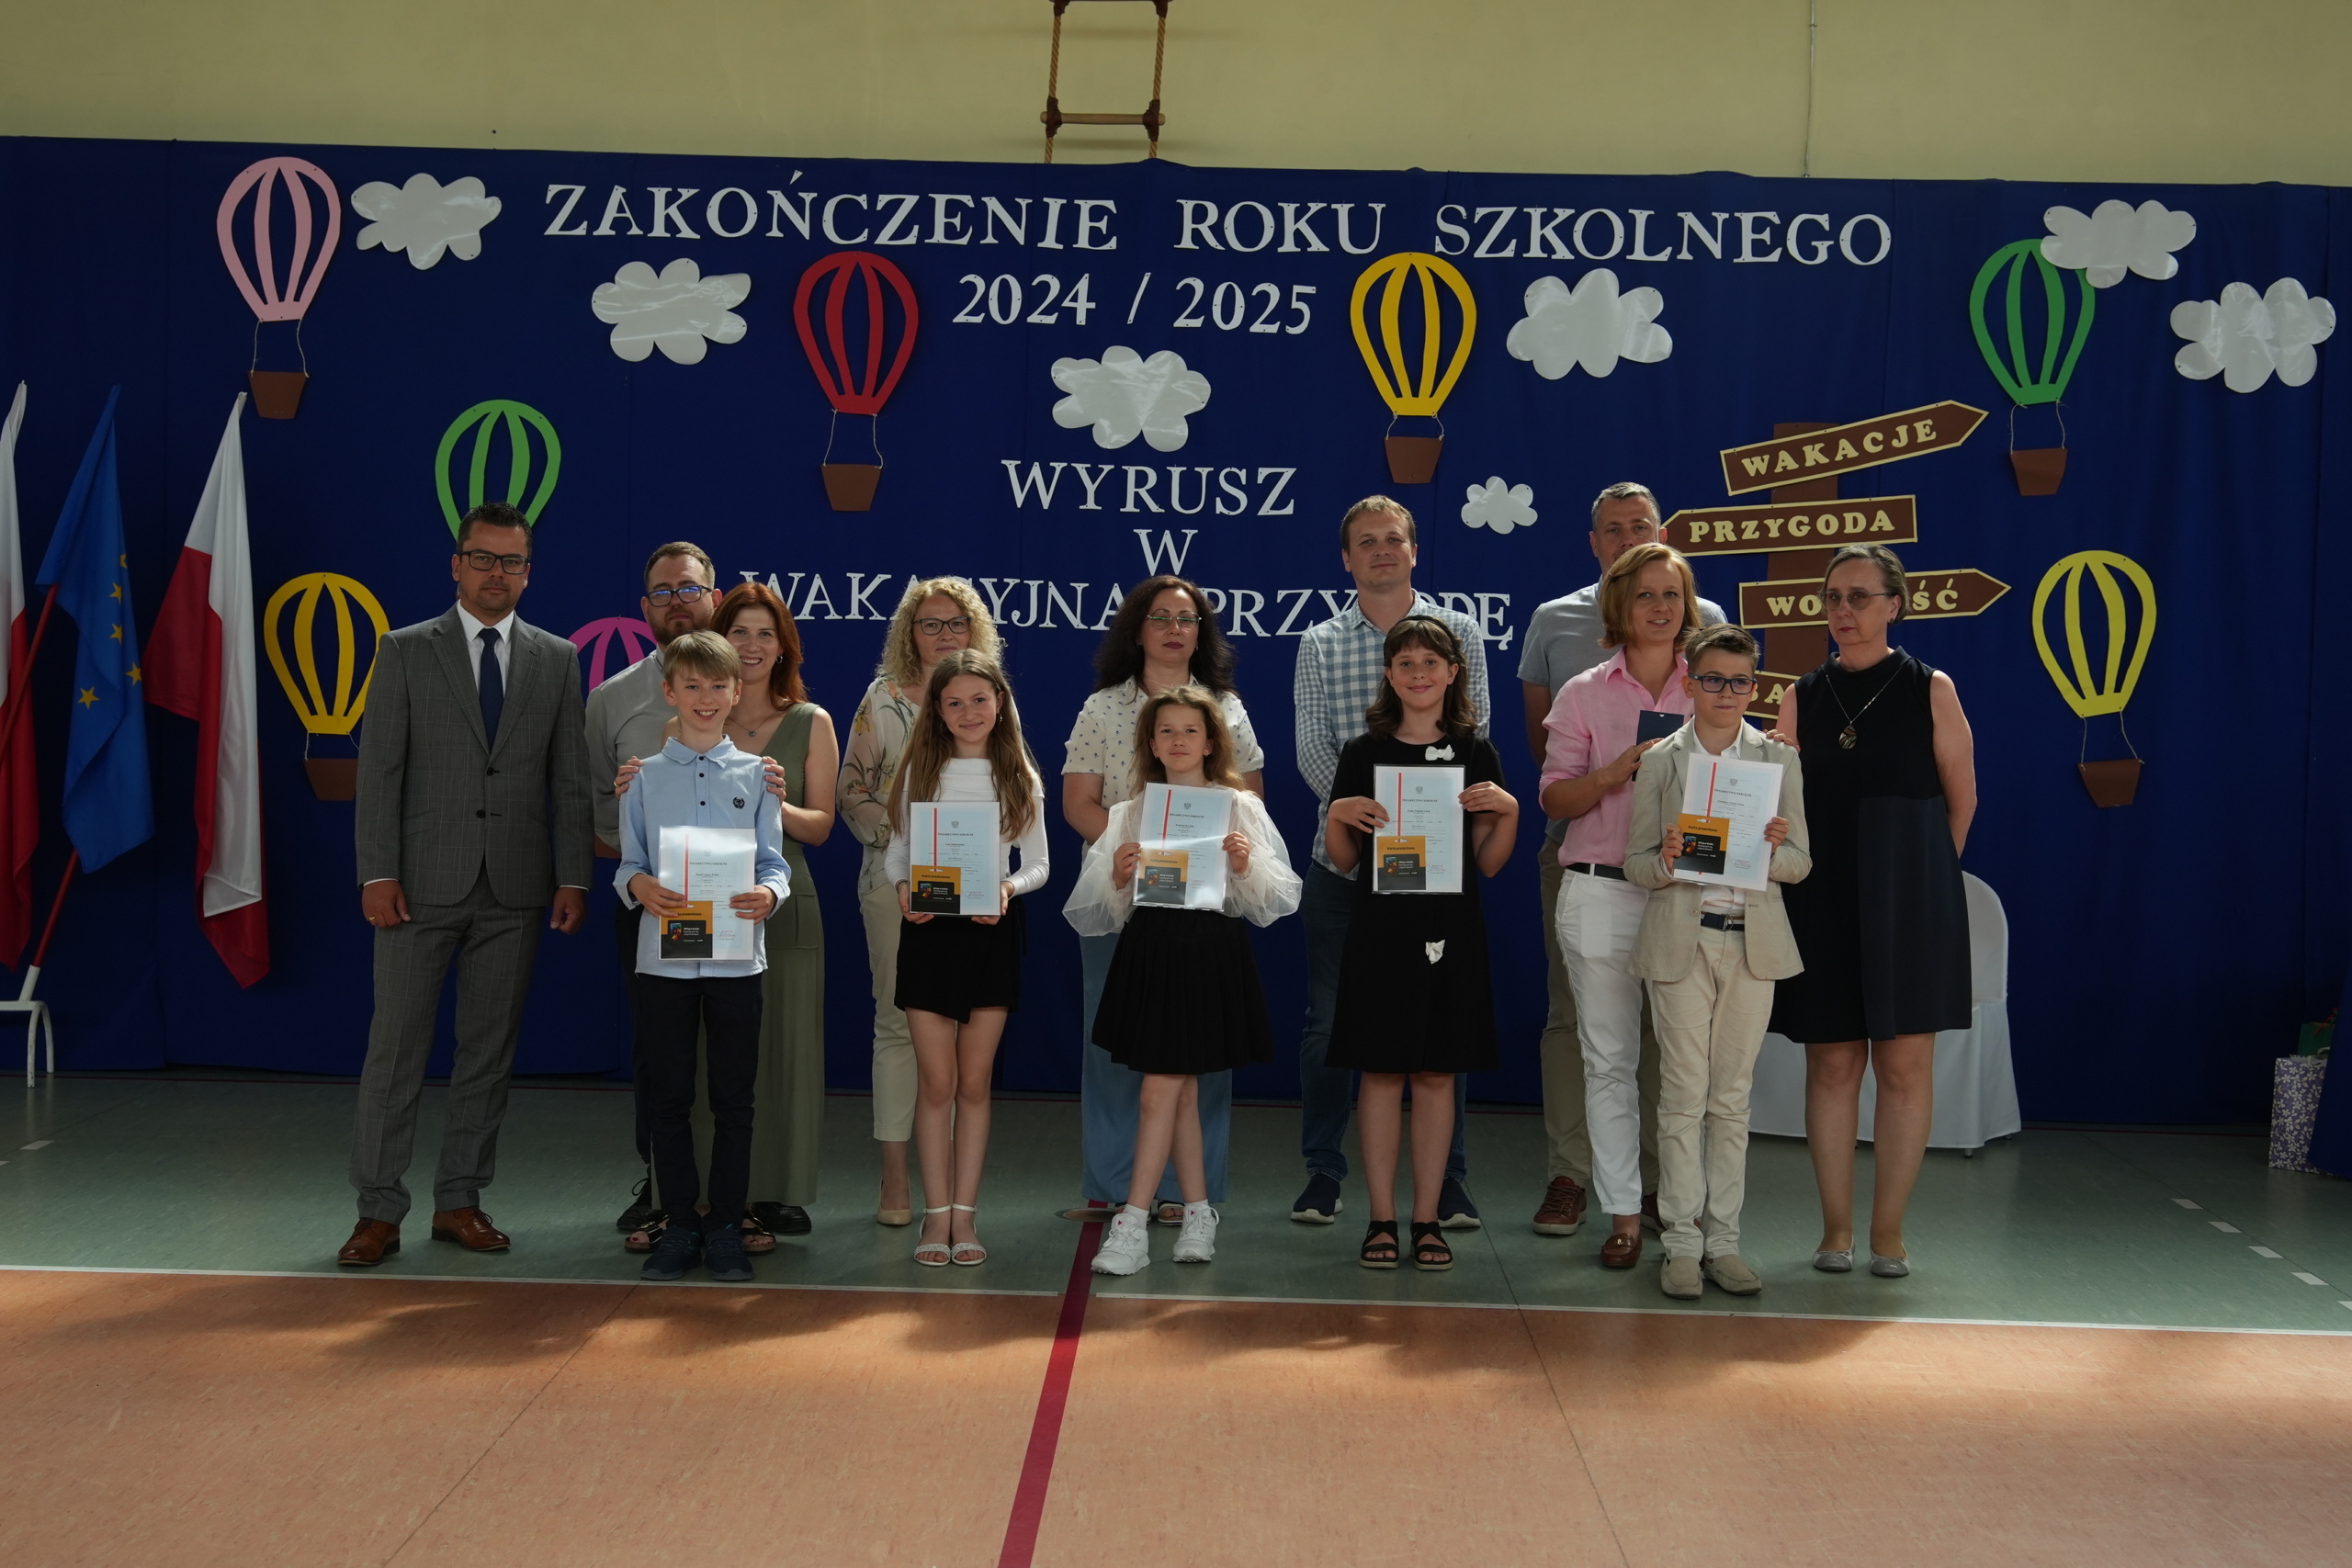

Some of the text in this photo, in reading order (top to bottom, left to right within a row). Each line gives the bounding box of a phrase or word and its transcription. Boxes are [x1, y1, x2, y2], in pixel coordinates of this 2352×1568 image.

[544, 170, 1891, 265] ZAKOŃCZENIE ROKU SZKOLNEGO
[953, 273, 1317, 334] 2024 / 2025
[1741, 419, 1937, 478] WAKACJE
[1001, 460, 1296, 515] WYRUSZ
[1134, 529, 1198, 577] W
[1689, 510, 1895, 543] PRZYGODA
[739, 570, 1126, 630] WAKYJN
[1202, 587, 1514, 650] PRZYDĘ
[1766, 578, 1959, 617] WOŚĆ
